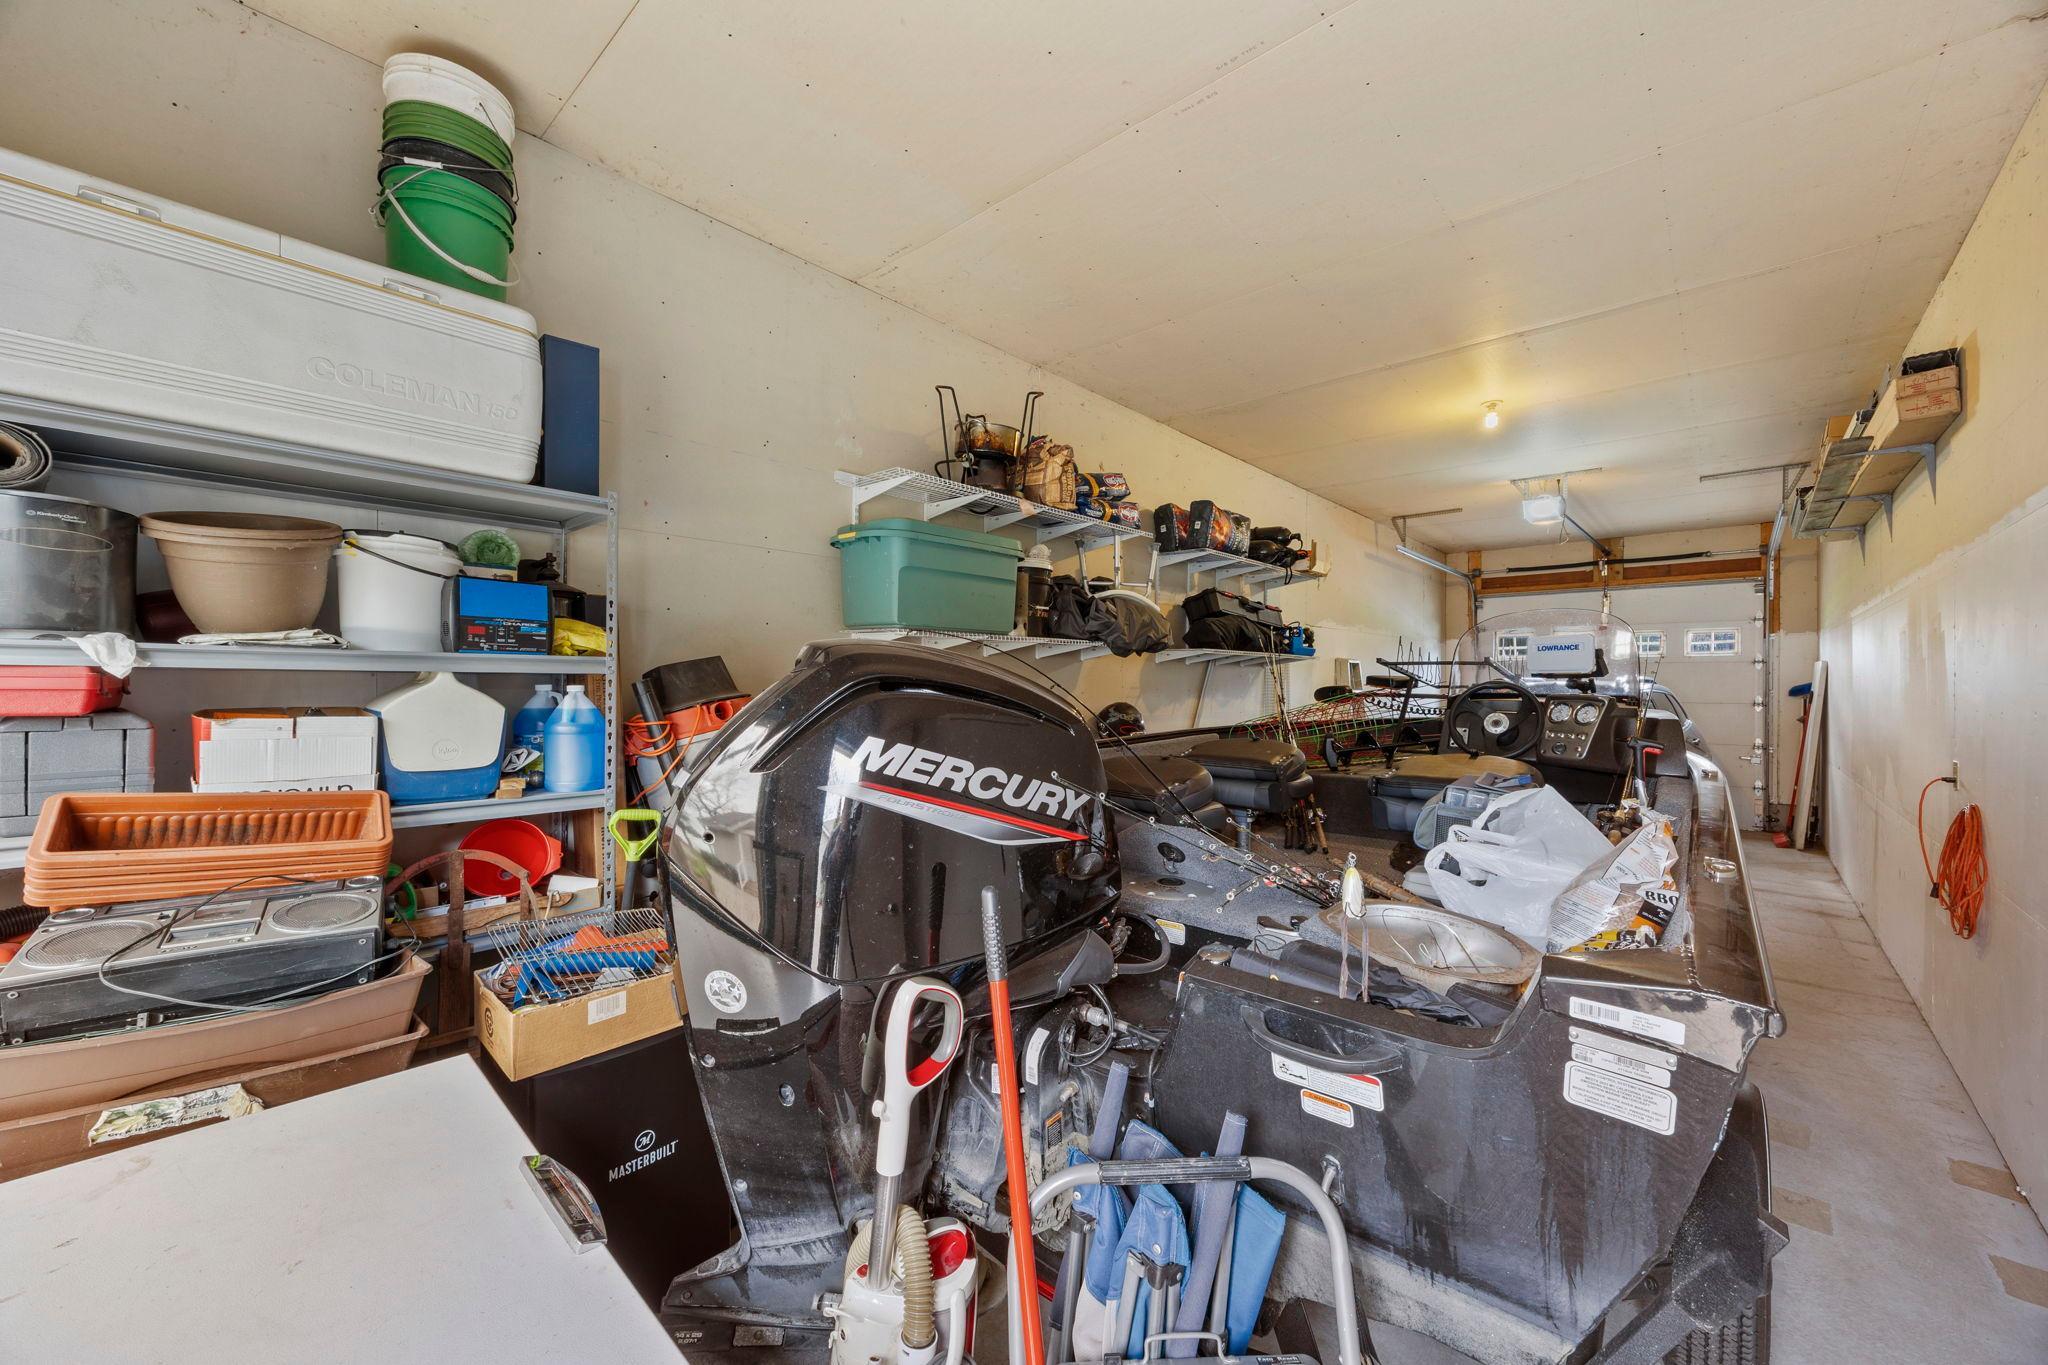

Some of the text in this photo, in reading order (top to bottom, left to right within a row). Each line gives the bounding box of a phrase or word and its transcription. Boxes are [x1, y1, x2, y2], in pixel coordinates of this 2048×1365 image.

[305, 356, 480, 415] COLEMAN
[1537, 643, 1580, 652] LOWRANCE
[851, 735, 1092, 821] MERCURY
[608, 1140, 679, 1183] MASTERBUILT
